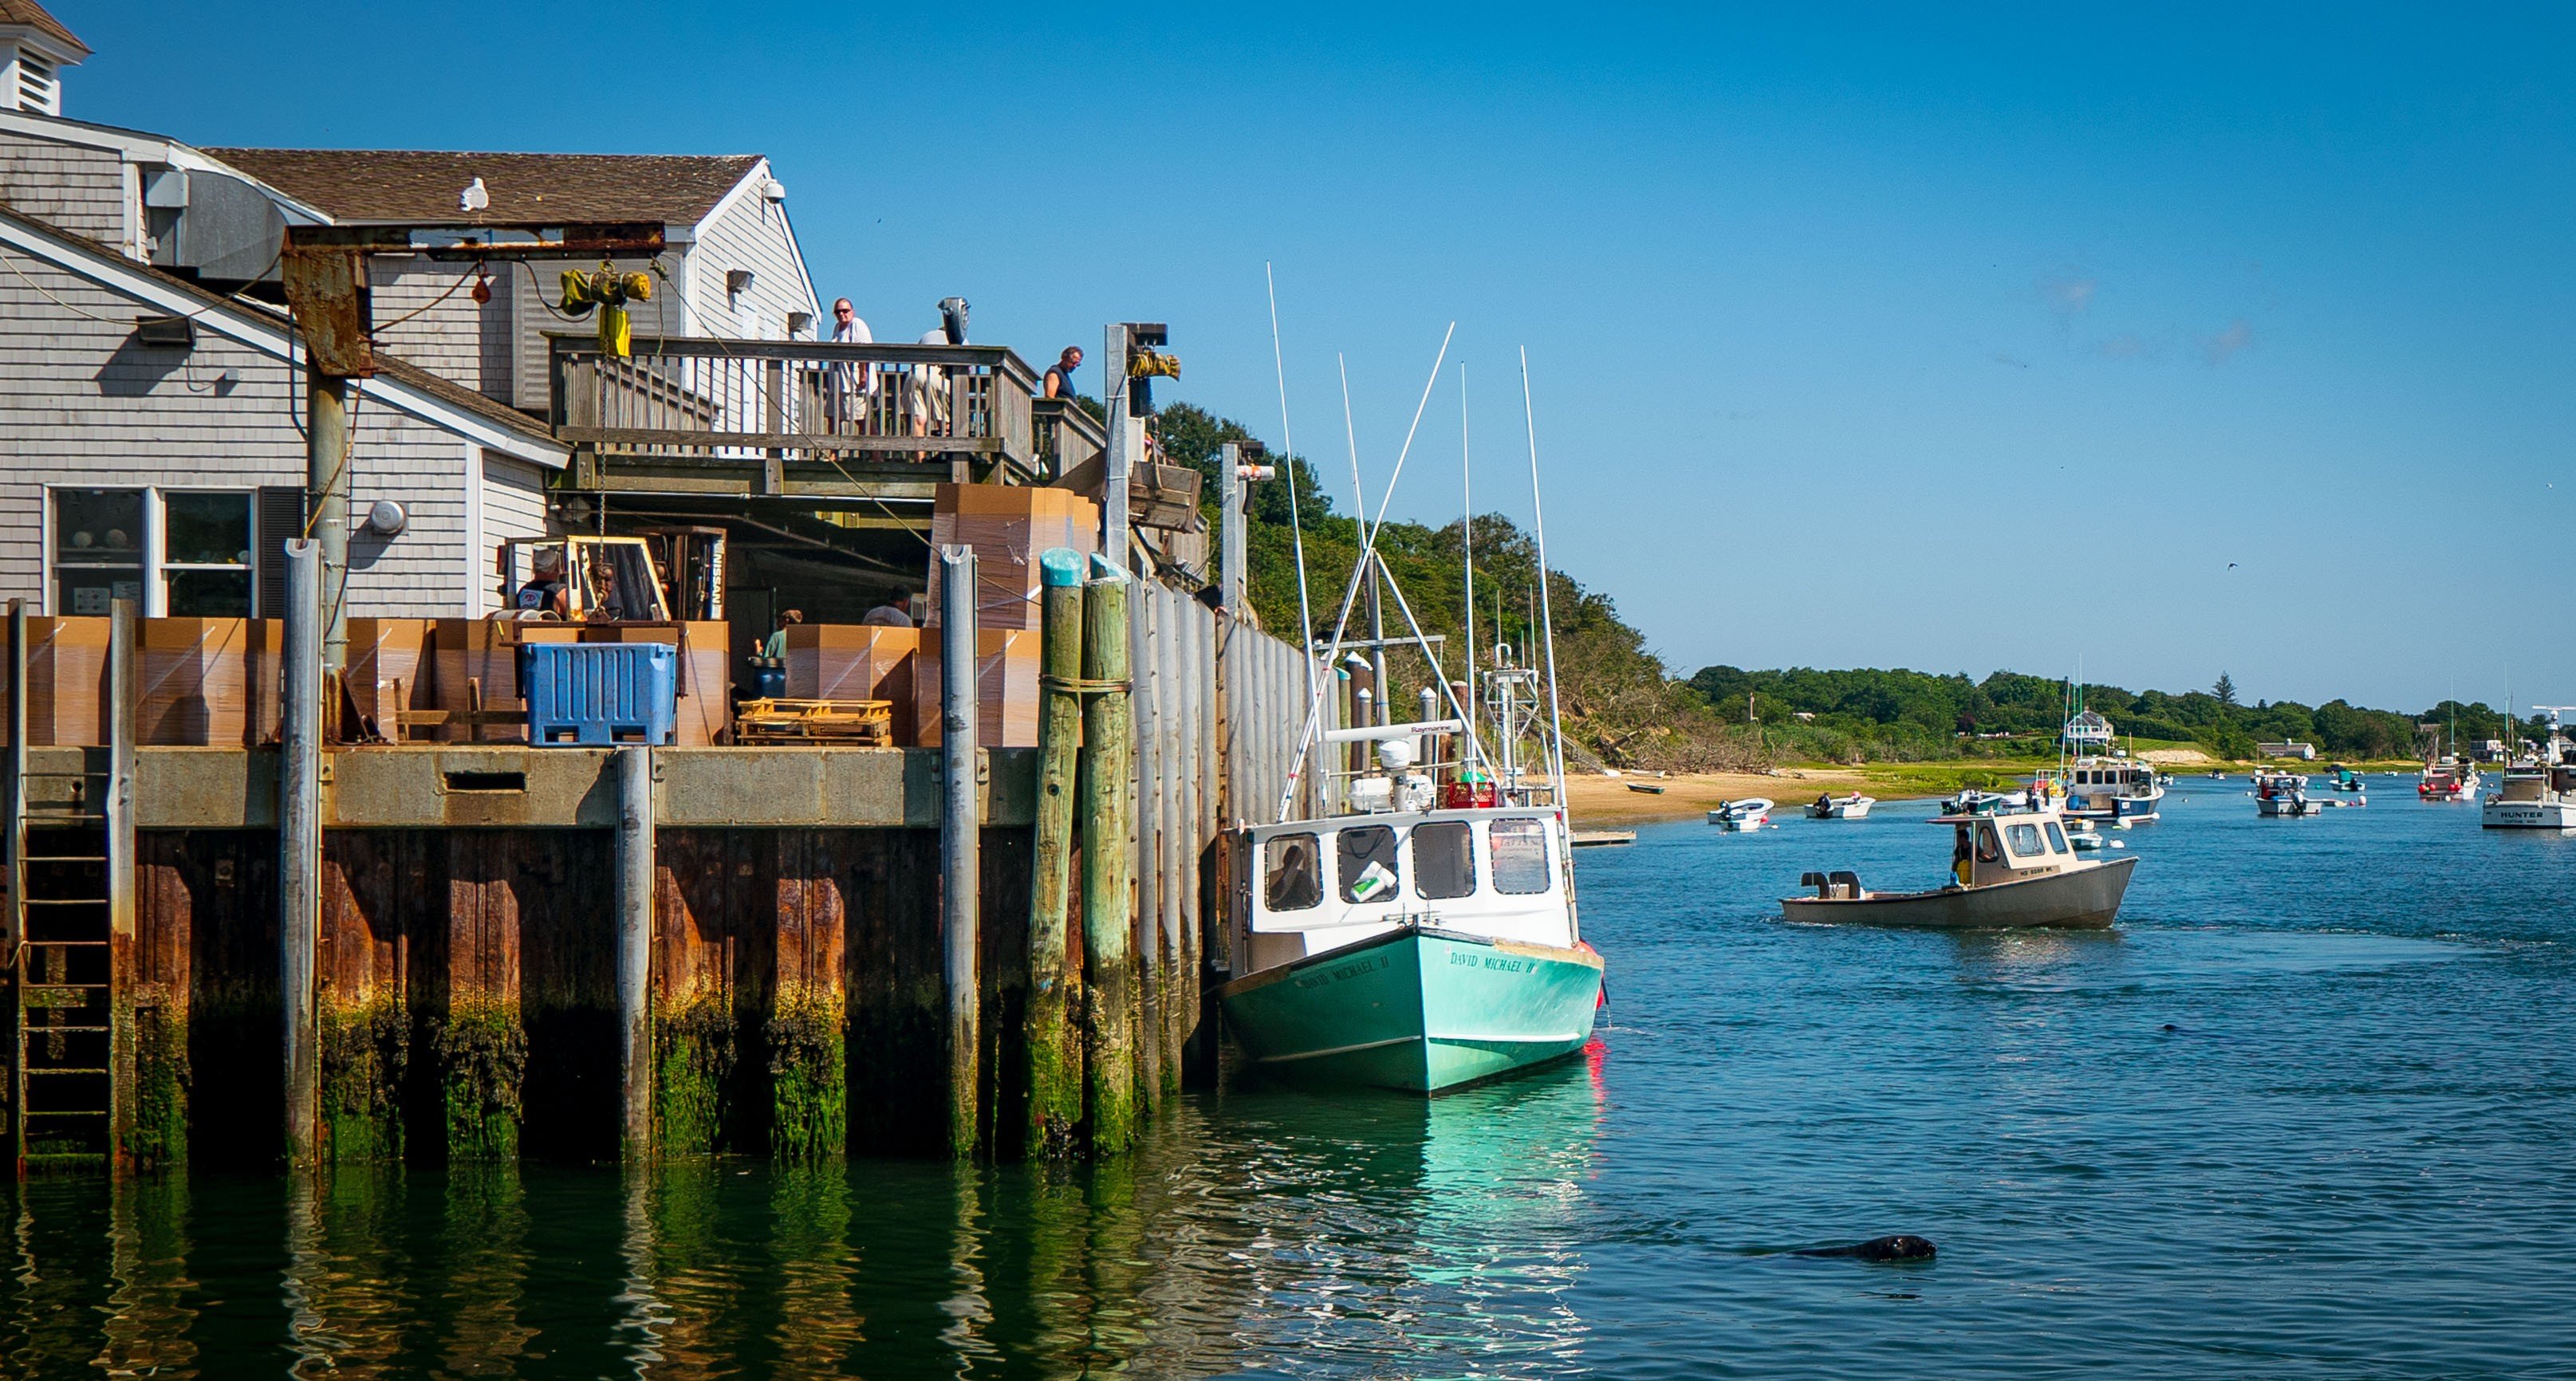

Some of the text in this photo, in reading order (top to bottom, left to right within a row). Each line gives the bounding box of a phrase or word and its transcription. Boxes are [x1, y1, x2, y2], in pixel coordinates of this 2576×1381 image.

[712, 553, 722, 604] NISSAN
[1302, 955, 1390, 990] DAVID MICHAEL II
[1450, 952, 1536, 973] DAVID MICHAEL II
